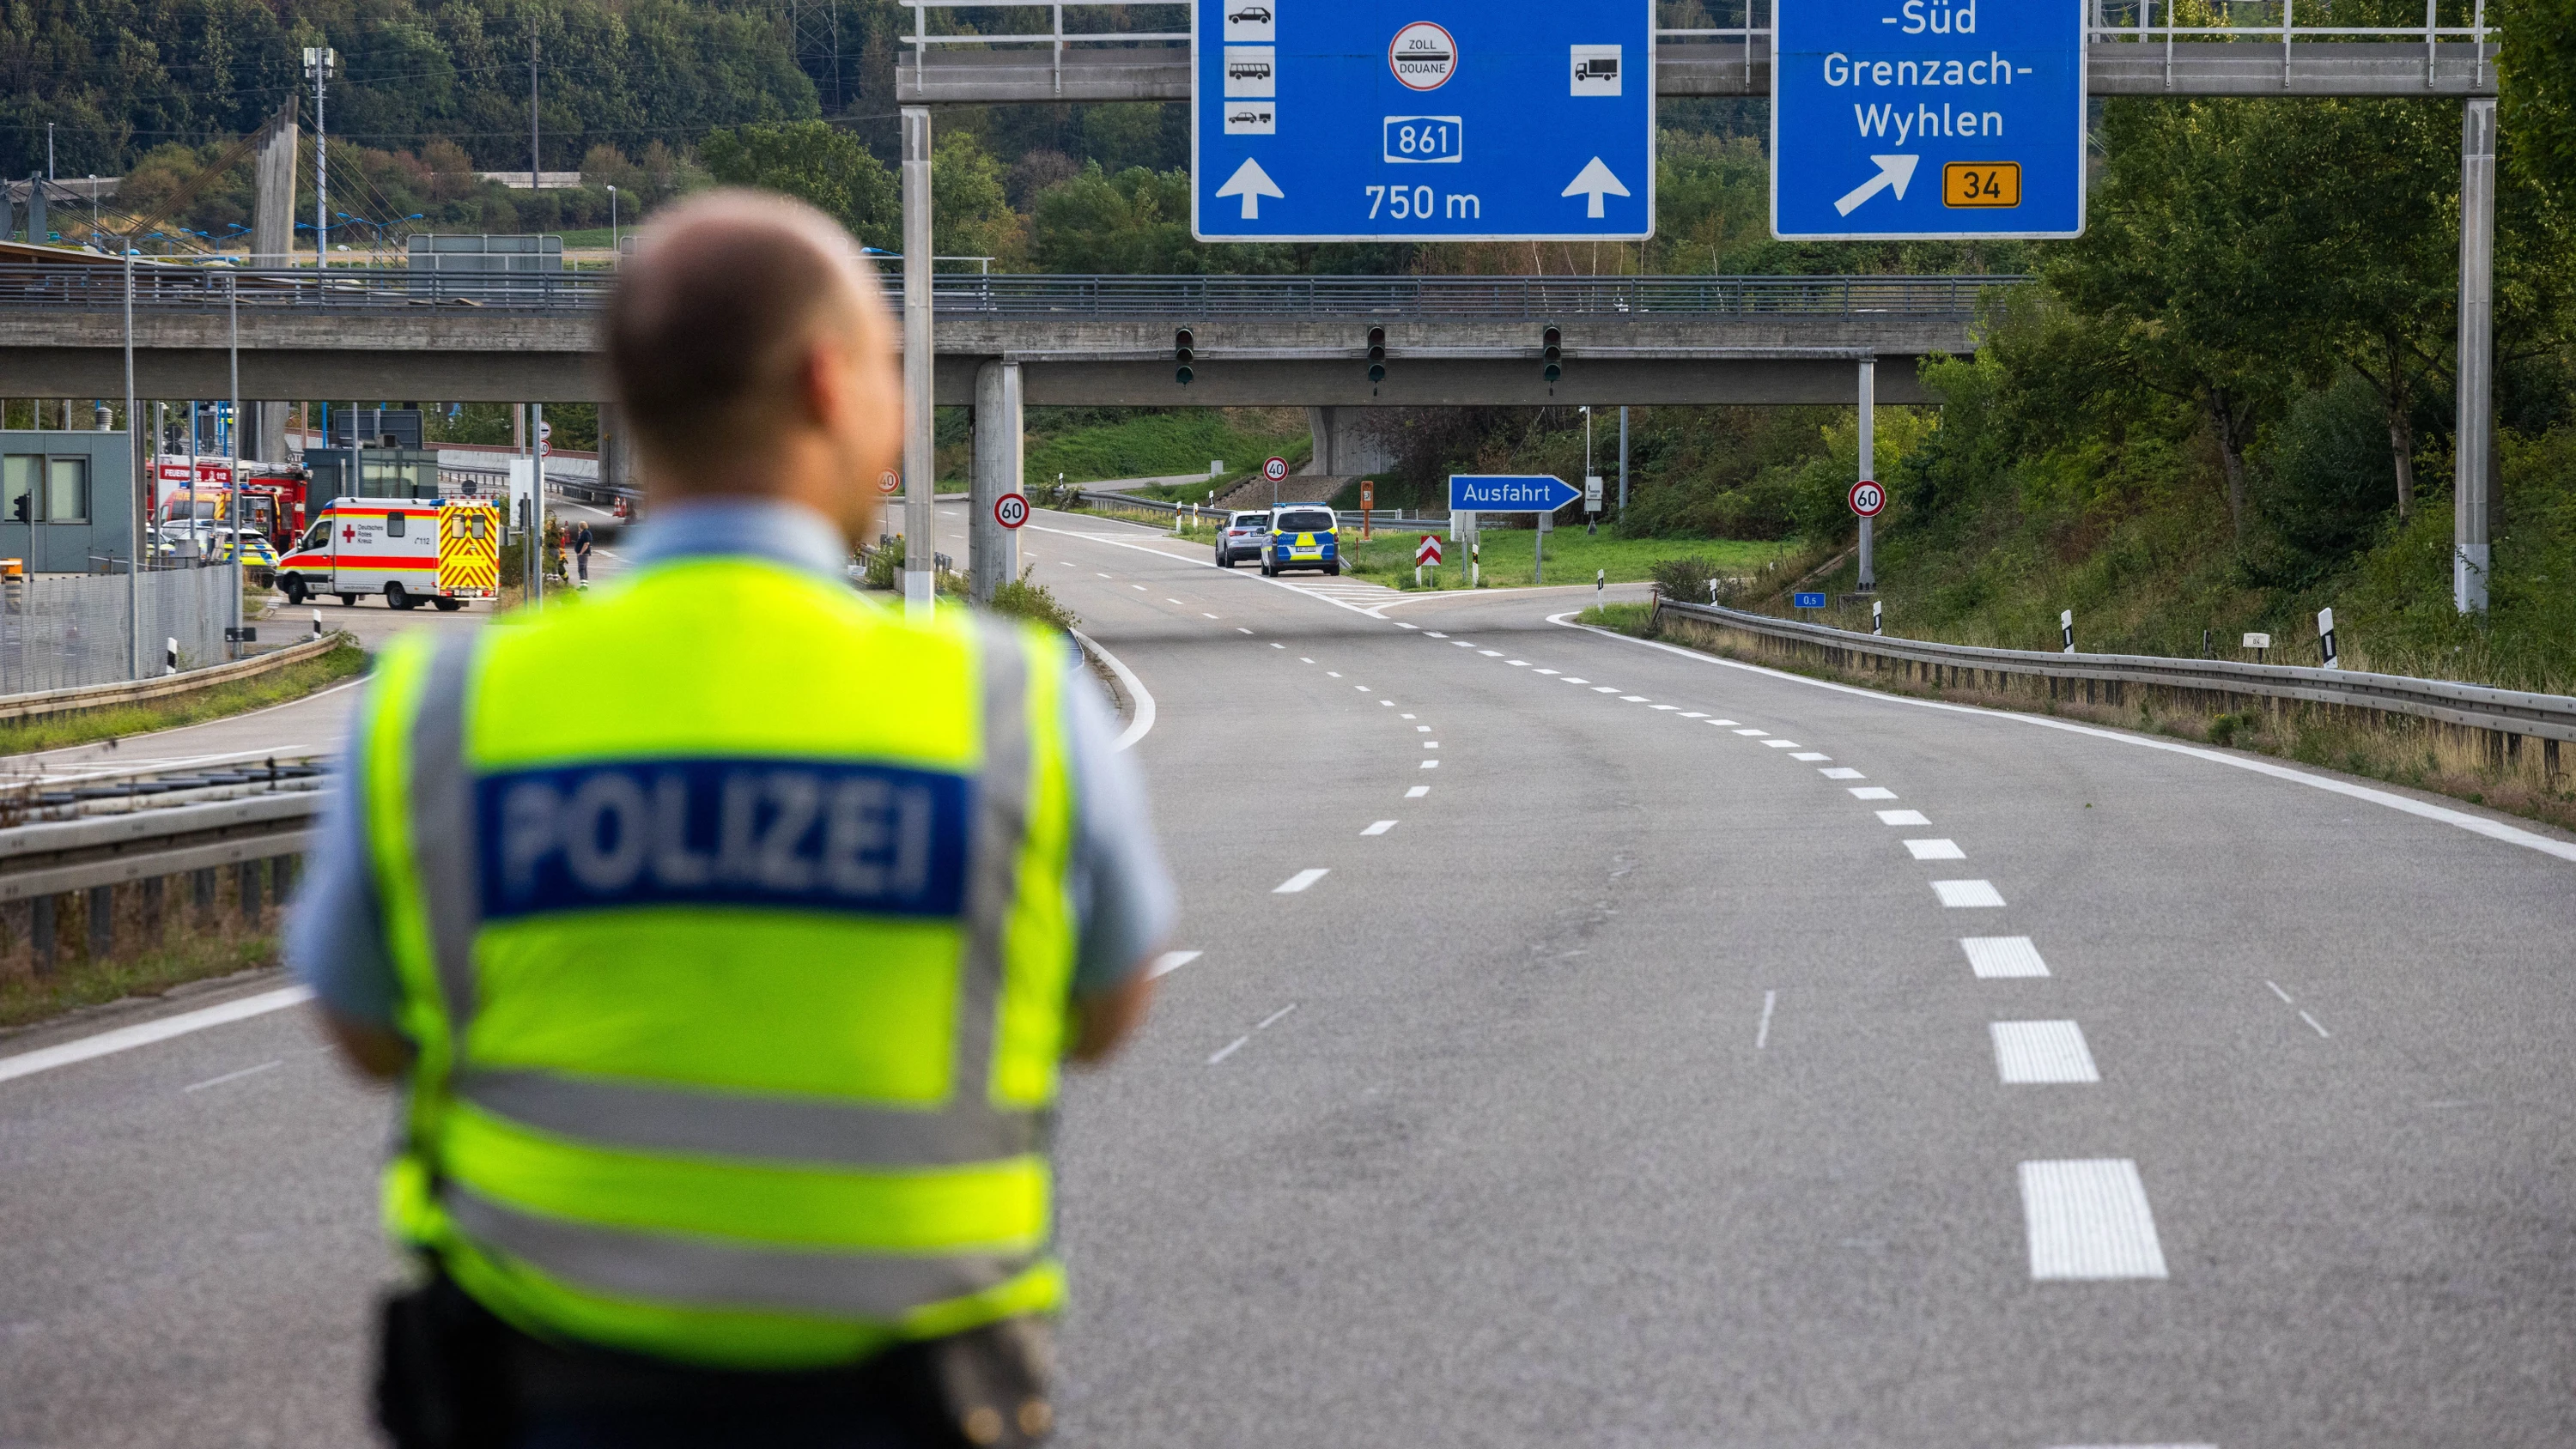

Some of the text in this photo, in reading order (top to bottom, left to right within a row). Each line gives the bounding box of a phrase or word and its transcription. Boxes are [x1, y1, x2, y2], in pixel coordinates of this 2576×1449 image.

[1881, 0, 1976, 33] -Süd
[1408, 39, 1437, 50] ZOLL
[1399, 63, 1447, 74] DOUANE
[1824, 51, 2032, 87] Grenzach-
[1854, 102, 2003, 146] Wyhlen
[1399, 125, 1447, 154] 861
[1963, 171, 2001, 199] 34
[1365, 185, 1480, 220] 750 m
[216, 471, 227, 480] 112
[1268, 463, 1284, 475] 40
[878, 474, 894, 487] 40
[1462, 483, 1551, 501] Ausfahrt
[1856, 490, 1878, 506] 60
[1001, 502, 1022, 519] 60
[498, 769, 936, 903] POLIZEI
